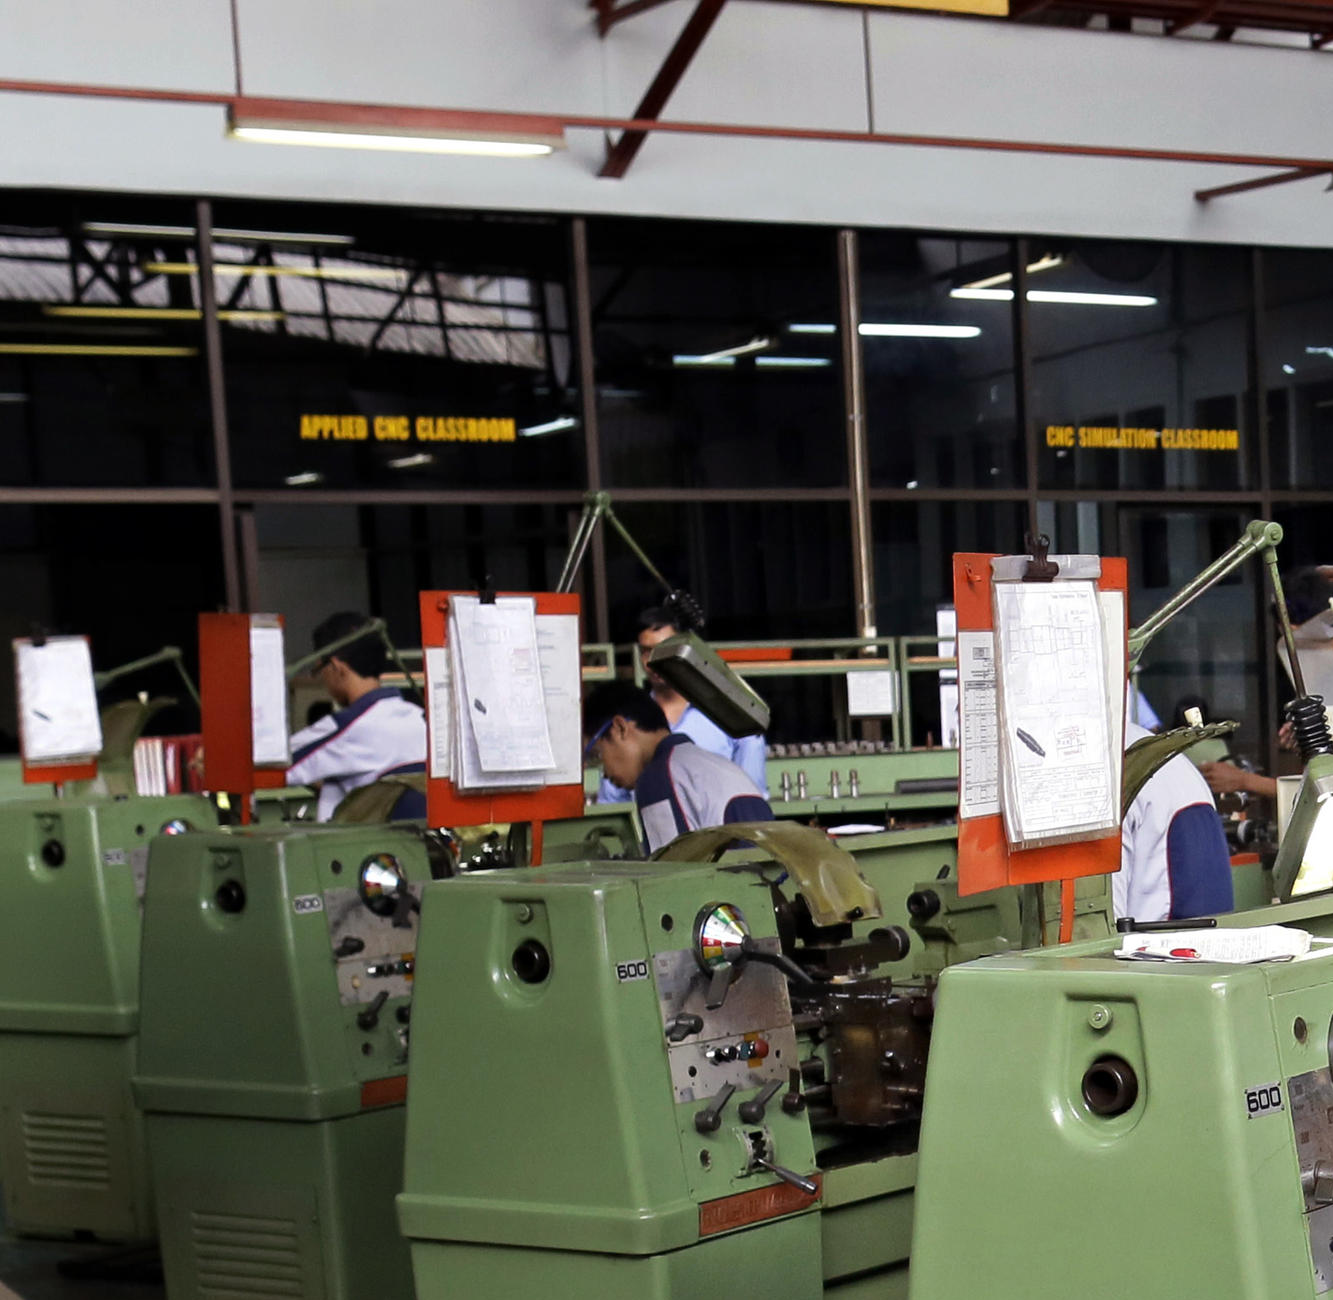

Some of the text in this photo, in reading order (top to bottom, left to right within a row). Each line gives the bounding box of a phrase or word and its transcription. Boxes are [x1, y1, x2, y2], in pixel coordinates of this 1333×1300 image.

[300, 414, 516, 442] APPLIED CNC CLASSROOM
[1046, 425, 1239, 450] CNC SIMULATION CLASSROOM
[617, 962, 647, 979] 600
[1246, 1086, 1281, 1112] 600
